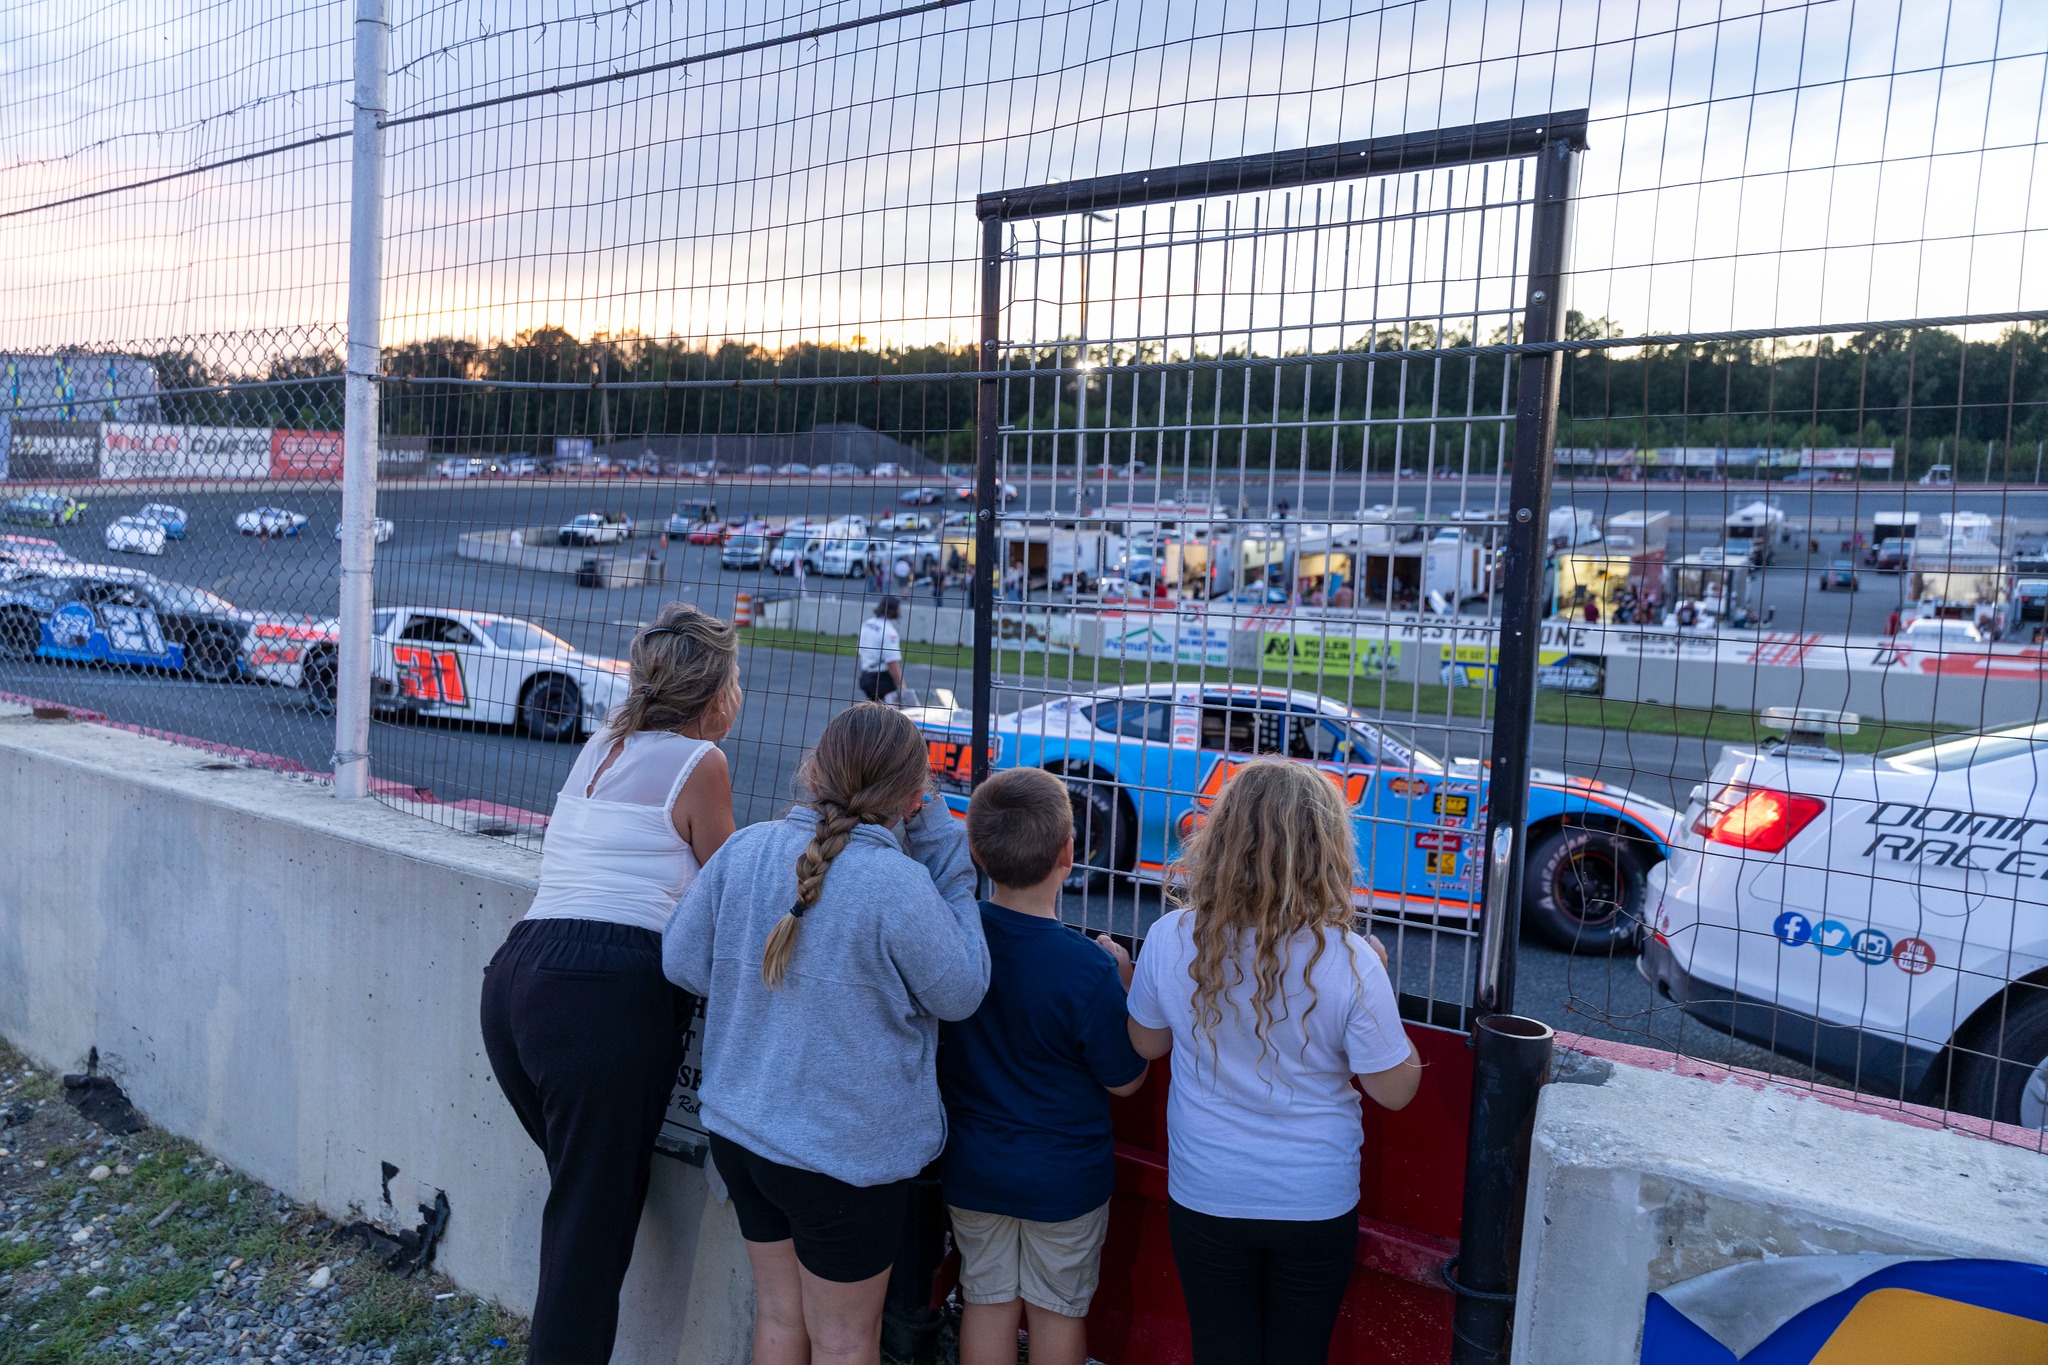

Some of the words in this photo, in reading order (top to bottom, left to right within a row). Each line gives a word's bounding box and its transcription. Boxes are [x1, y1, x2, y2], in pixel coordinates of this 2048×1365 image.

[1402, 616, 1497, 642] RESTAR
[1540, 626, 1586, 648] ONE
[1106, 638, 1172, 654] PemaTeat
[393, 645, 468, 706] 31
[1862, 834, 2048, 880] RACE
[1906, 940, 1926, 955] You
[1901, 954, 1926, 970] Tube
